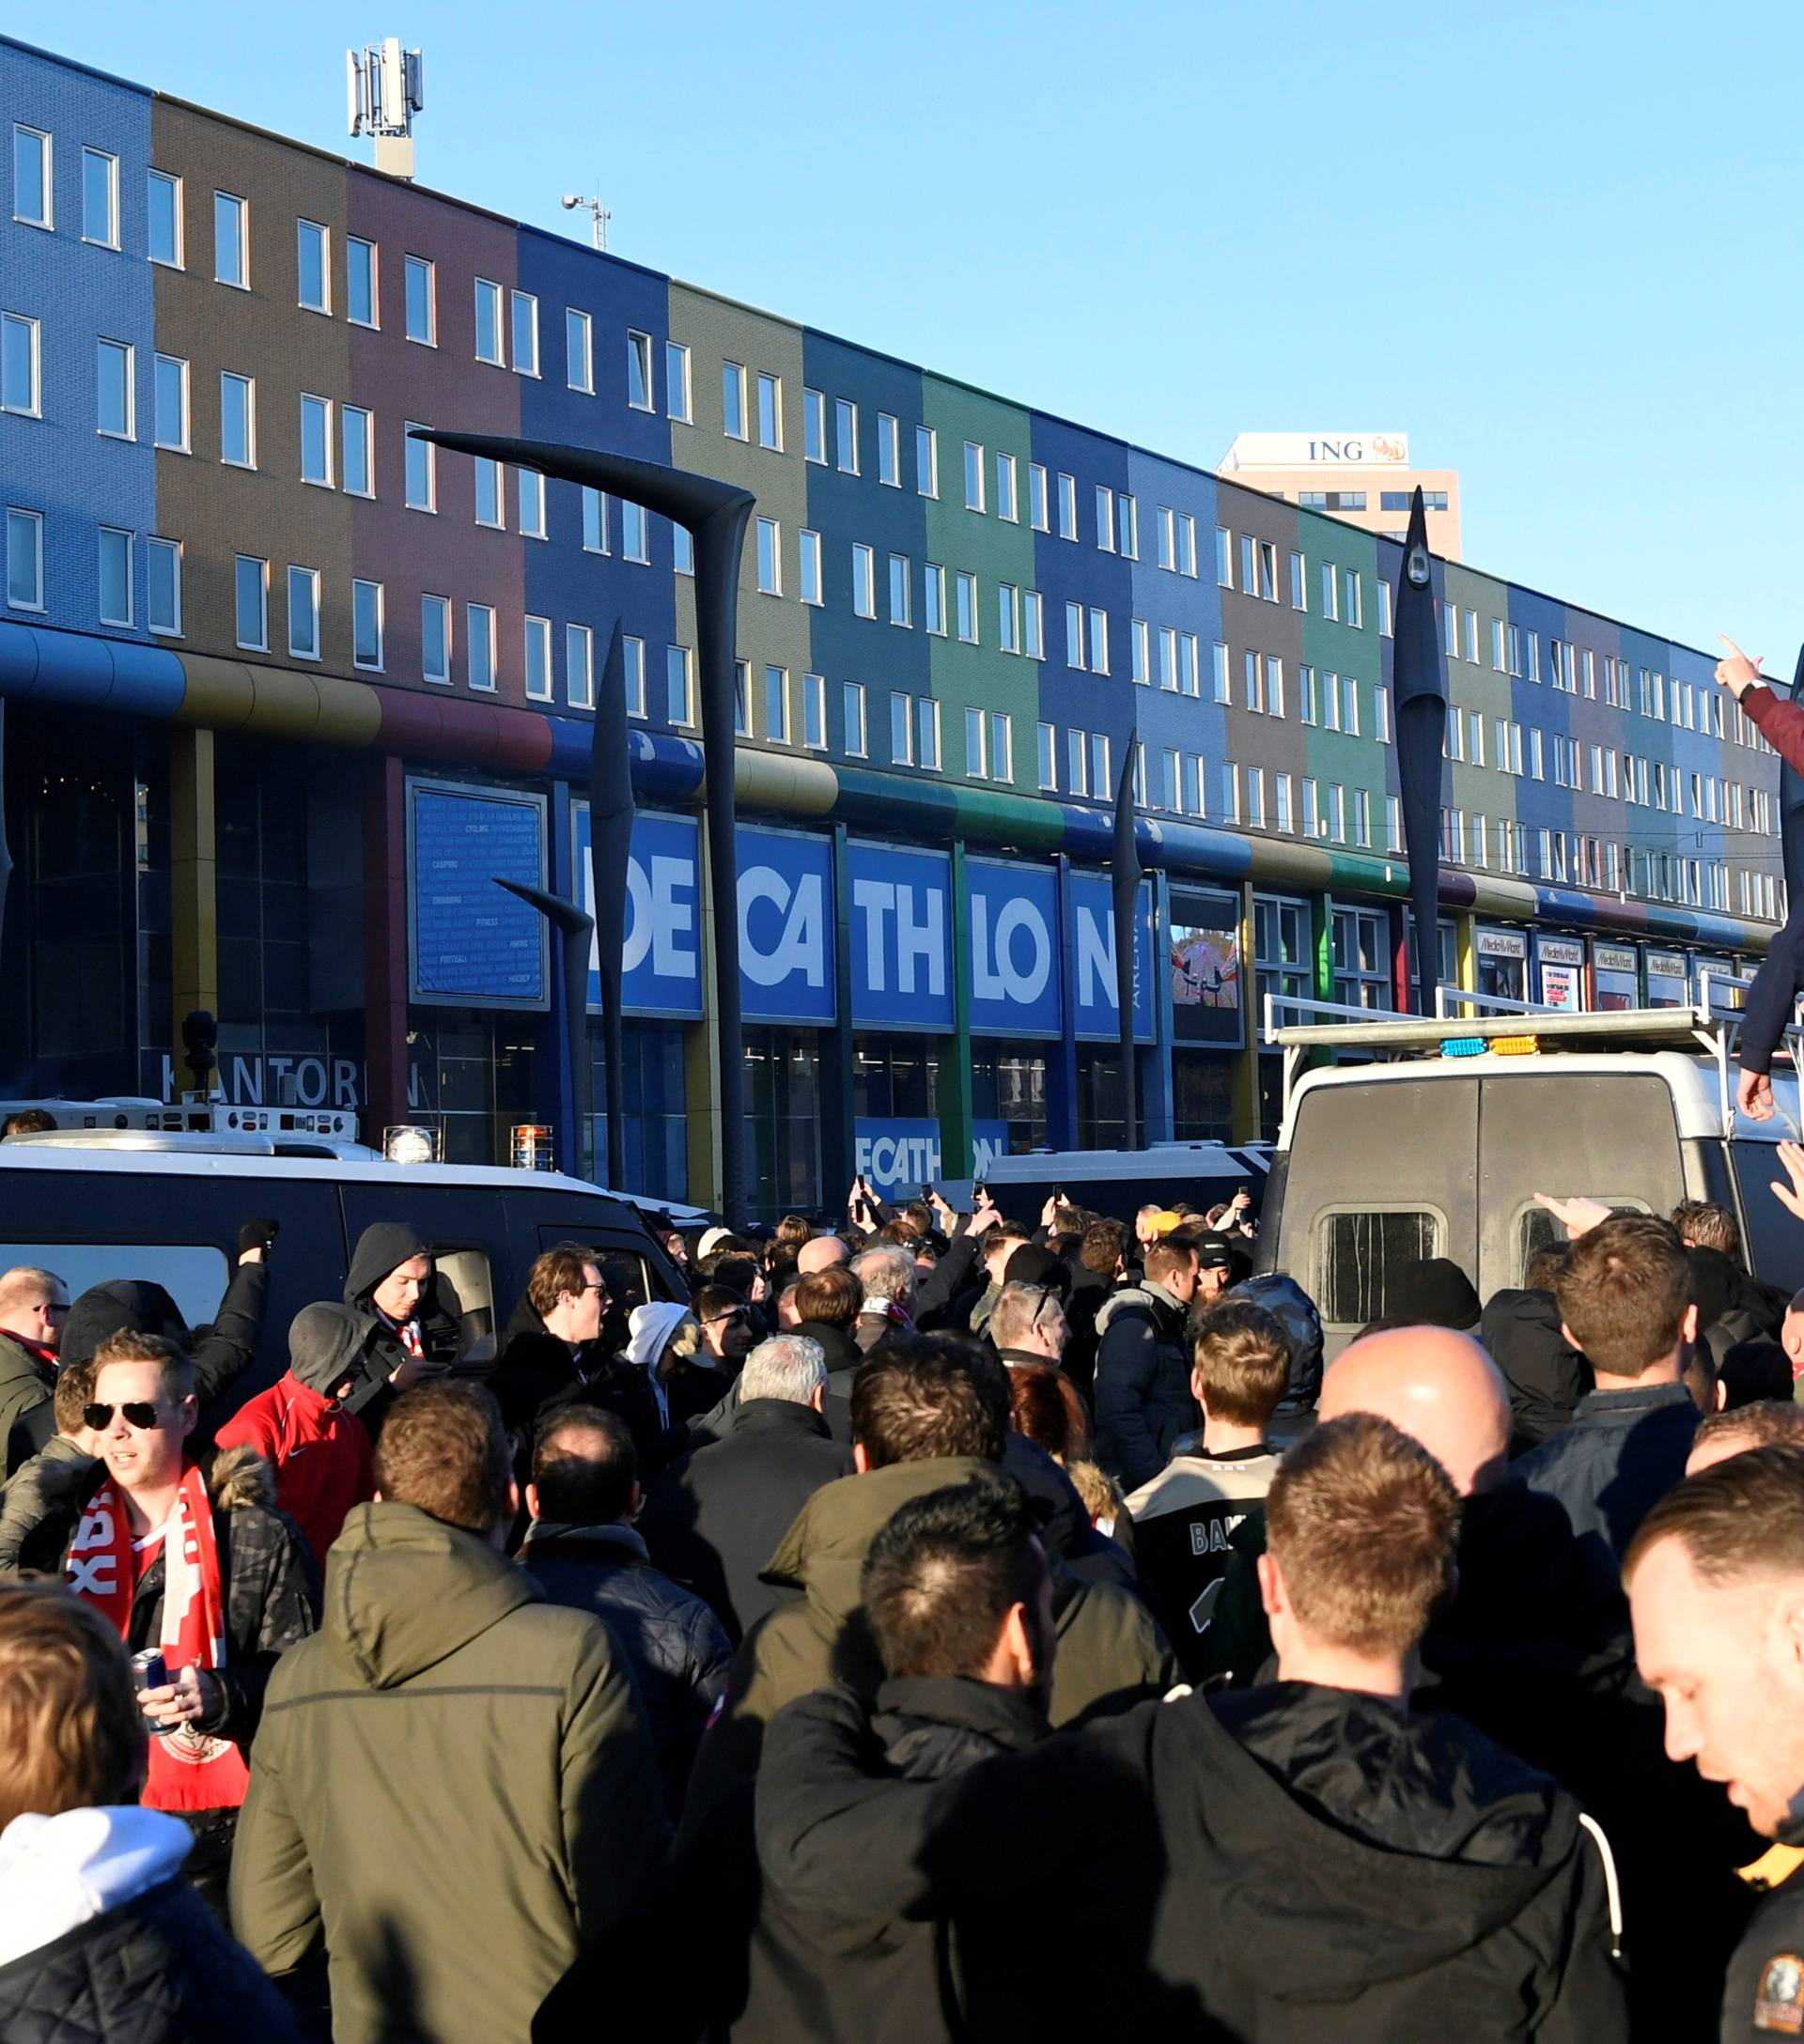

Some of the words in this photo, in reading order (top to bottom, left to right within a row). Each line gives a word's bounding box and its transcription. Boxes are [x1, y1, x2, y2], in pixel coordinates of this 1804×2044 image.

[1308, 441, 1362, 461] ING
[432, 860, 459, 869] CAMPING
[475, 918, 499, 927] FITNESS
[440, 954, 468, 965] FOOTBALL
